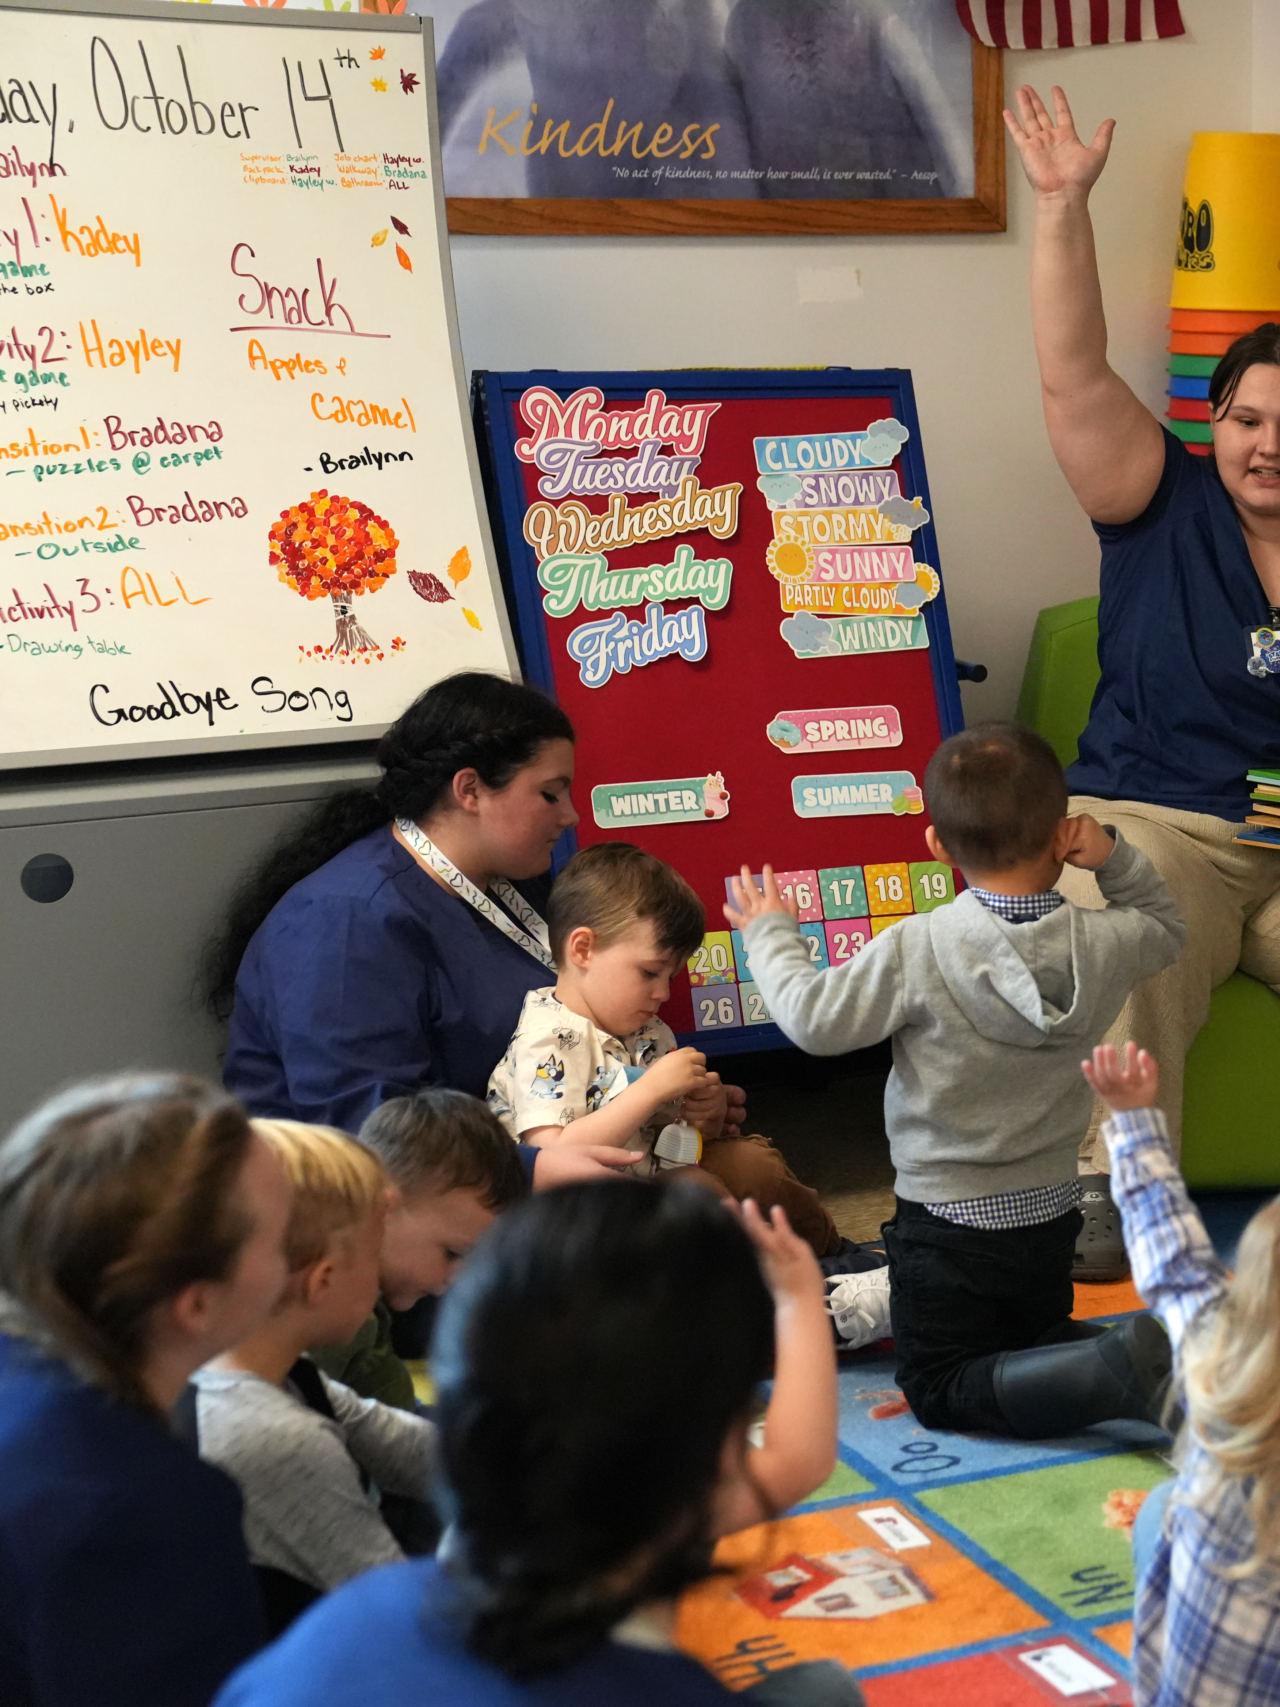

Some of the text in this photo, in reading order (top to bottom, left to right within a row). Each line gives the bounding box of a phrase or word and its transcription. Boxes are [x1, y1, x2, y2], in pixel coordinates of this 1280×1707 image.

[91, 36, 259, 139] October
[477, 97, 721, 160] Kindness
[290, 176, 325, 192] Hayley
[384, 165, 427, 180] Bradana
[632, 168, 650, 179] act
[652, 166, 665, 185] of
[665, 167, 713, 181] kindness,
[716, 170, 728, 179] no
[730, 168, 765, 180] matter
[767, 167, 790, 180] how
[823, 168, 831, 180] is
[834, 171, 854, 180] ever
[911, 170, 938, 184] Aesop
[48, 193, 141, 267] Kadey
[25, 282, 55, 295] box
[230, 243, 355, 333] Snack
[79, 318, 181, 374] Hayley
[247, 338, 328, 381] Apples
[14, 369, 70, 393] game
[311, 392, 417, 433] Caramel
[516, 389, 720, 460] Monday
[103, 415, 224, 451] Bradana
[33, 457, 122, 482] puzzles
[159, 445, 224, 468] carpet
[319, 446, 414, 475] Brailynn
[539, 442, 698, 498] Tuesday
[765, 438, 862, 470] CLOUDY
[126, 490, 249, 527] Bradana
[802, 475, 893, 506] SNOWY
[527, 478, 741, 557] Wednesday
[780, 511, 884, 541] STORMY
[541, 548, 730, 614] Thursday
[819, 550, 905, 580] SUNNY
[120, 566, 213, 609] ALL
[785, 585, 899, 609] PARTLY CLOUDY
[570, 605, 706, 686] Friday
[838, 620, 913, 650] WINDY
[89, 675, 354, 727] Goodbye Song
[804, 717, 889, 742] SPRING
[610, 790, 698, 816] WINTER
[803, 783, 894, 807] SUMMER
[829, 879, 855, 906] 17
[875, 875, 904, 902] 18
[920, 873, 948, 899] 19
[694, 944, 728, 973] 20
[833, 931, 866, 959] 23
[699, 997, 734, 1027] 26
